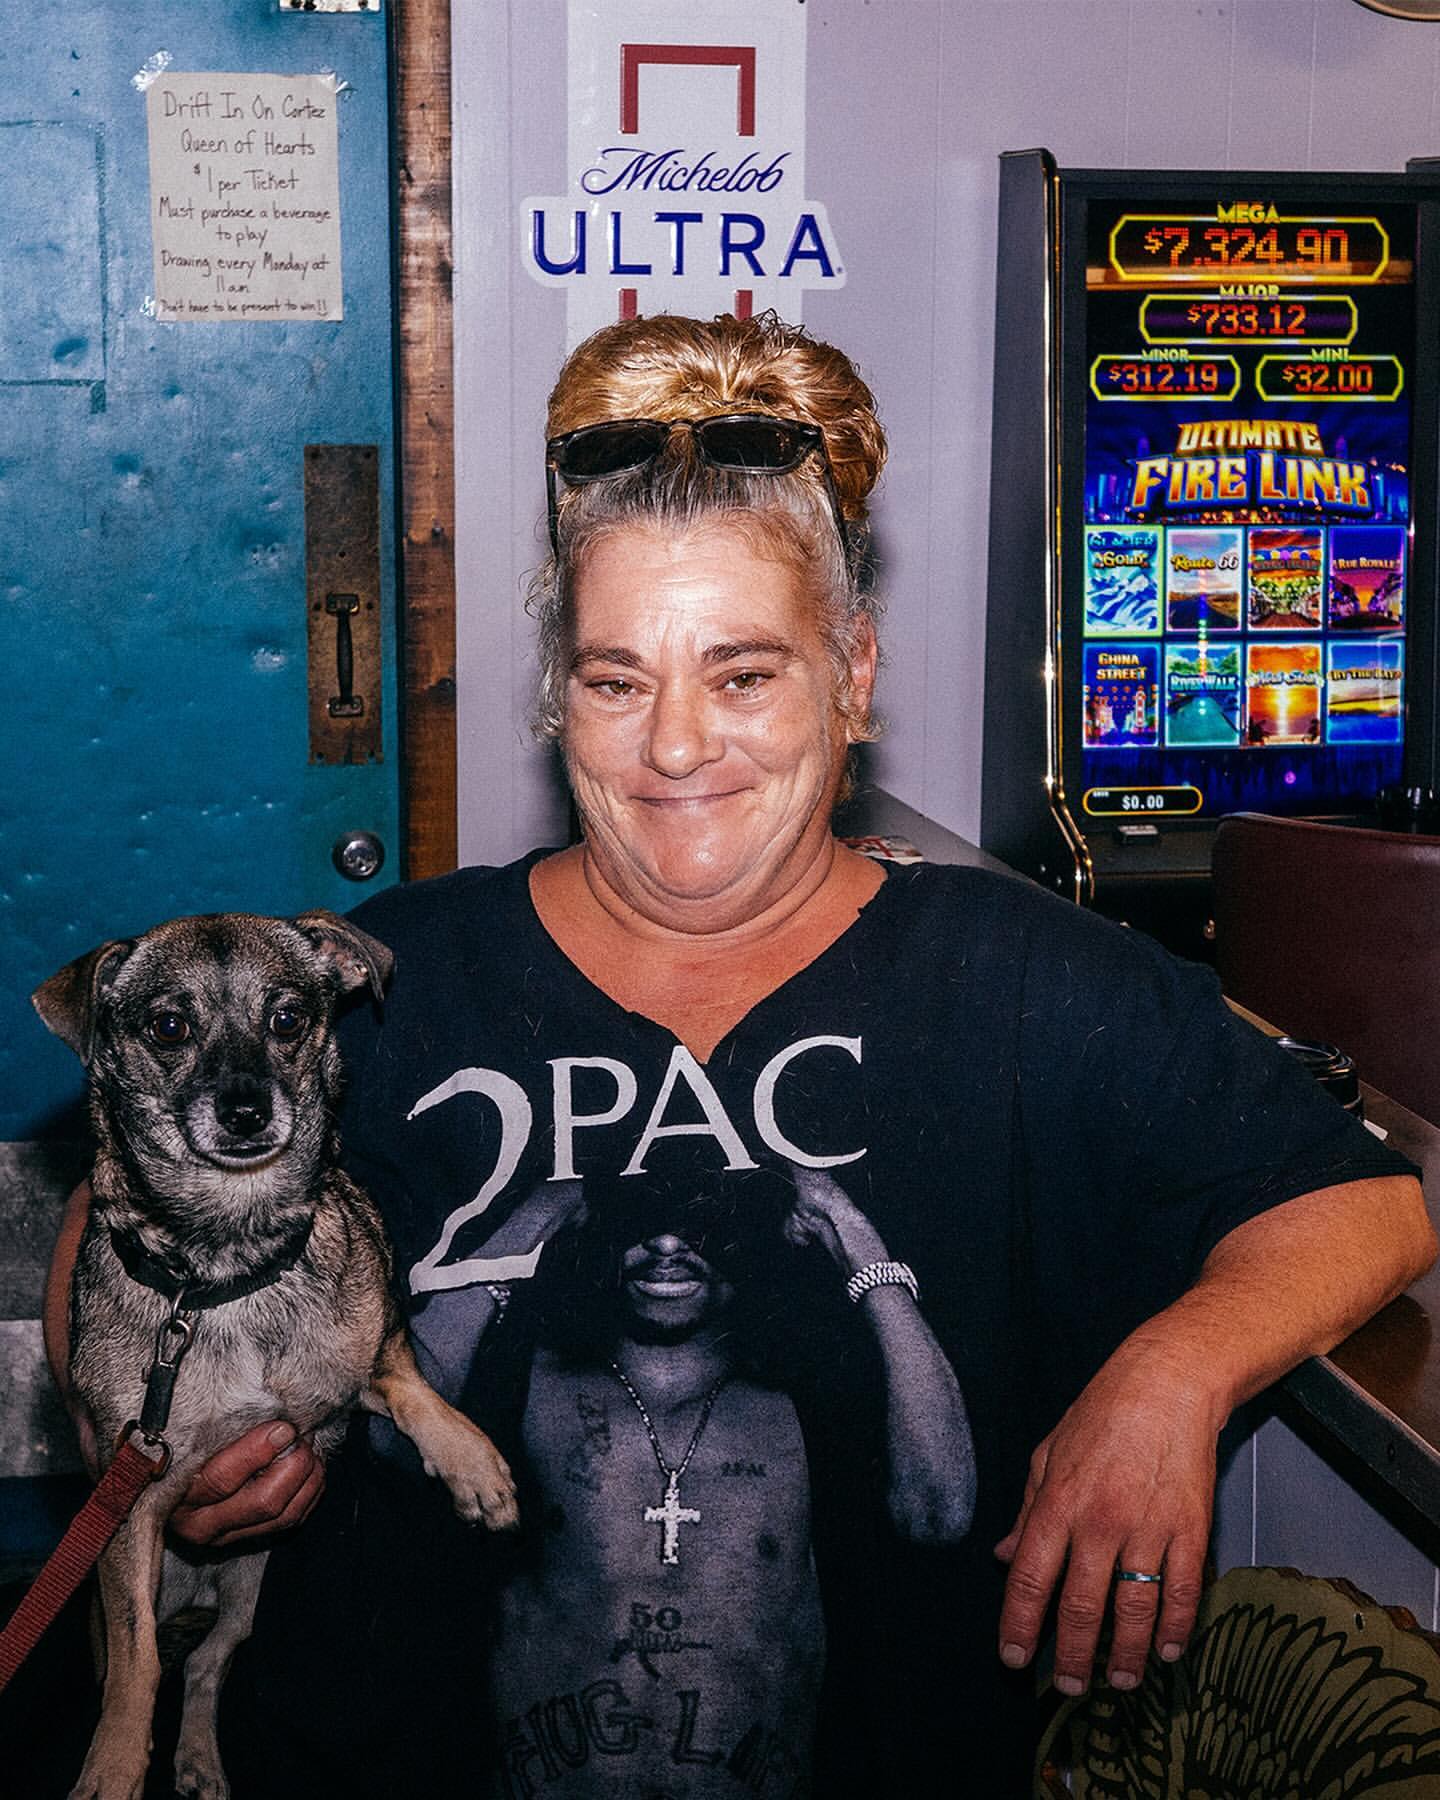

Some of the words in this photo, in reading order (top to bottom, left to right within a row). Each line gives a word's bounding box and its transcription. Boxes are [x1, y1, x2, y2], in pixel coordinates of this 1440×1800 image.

[163, 91, 212, 118] Drift
[220, 92, 244, 119] In
[252, 95, 274, 120] On
[282, 94, 326, 119] Cortez
[181, 128, 228, 153] Queen
[234, 129, 256, 154] of
[265, 132, 316, 156] Hearts
[218, 179, 240, 199] per
[243, 168, 300, 191] Ticket
[581, 147, 793, 195] Michelob
[159, 196, 195, 220] Must
[202, 201, 255, 228] purchase
[260, 209, 268, 218] a
[272, 200, 332, 224] beverage
[1217, 201, 1280, 223] MEGA
[216, 224, 231, 241] to
[236, 225, 268, 248] play
[532, 210, 836, 277] ULTRA
[161, 250, 211, 277] Drawing
[217, 257, 256, 279] every
[263, 251, 309, 280] Monday
[312, 253, 330, 271] at
[1220, 284, 1280, 300] MAJOR
[189, 299, 209, 312] have
[213, 300, 224, 311] to
[227, 300, 238, 312] be
[241, 299, 281, 315] present
[285, 299, 298, 311] to
[1187, 304, 1306, 335] $733.12
[1142, 349, 1190, 362] MINOR
[1311, 348, 1349, 362] MINI
[1108, 364, 1218, 392] $312.19
[1283, 364, 1373, 392] $32.00
[1177, 420, 1322, 452] ULTIMATE
[1133, 457, 1248, 507] FIRE
[1259, 452, 1370, 507] LINK
[1171, 555, 1216, 572] Route
[1218, 555, 1239, 570] 66
[1098, 653, 1140, 665] CHINA
[1096, 667, 1147, 680] STREET
[1122, 795, 1164, 810] $0.00
[405, 1035, 867, 1295] 2PAC
